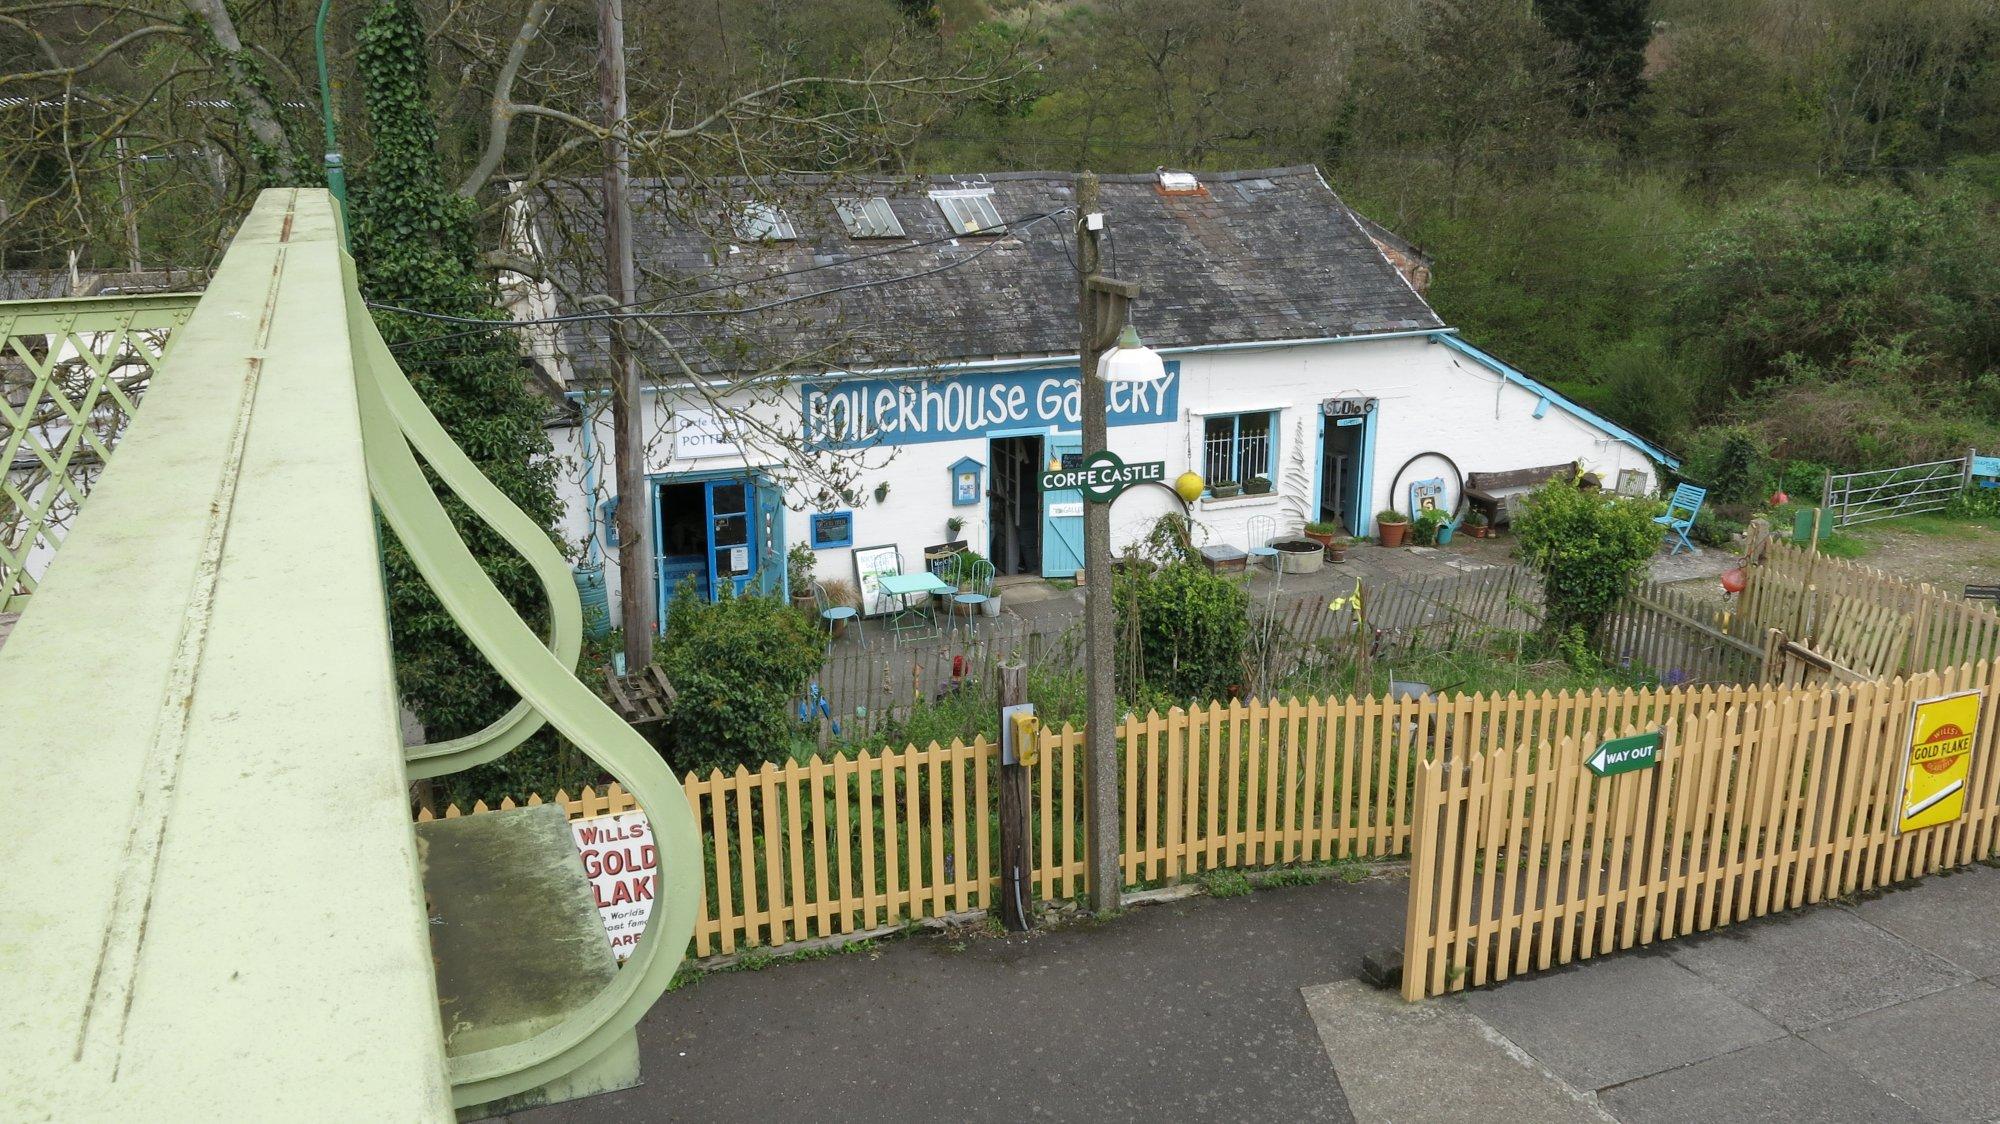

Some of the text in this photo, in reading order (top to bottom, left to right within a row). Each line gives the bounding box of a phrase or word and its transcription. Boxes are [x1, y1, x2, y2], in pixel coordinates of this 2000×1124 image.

[1037, 372, 1175, 423] GaeRY
[1364, 398, 1375, 413] 6
[680, 416, 740, 428] Cfe Caste
[682, 432, 739, 446] POTTE
[1043, 464, 1160, 488] CORFE CASTLE
[1064, 505, 1083, 513] GALLE
[1606, 746, 1654, 764] WAY OUT
[1914, 737, 1970, 760] GOLD FLAKE
[581, 844, 657, 879] GOLD
[590, 874, 657, 908] LAK
[628, 918, 648, 929] fam
